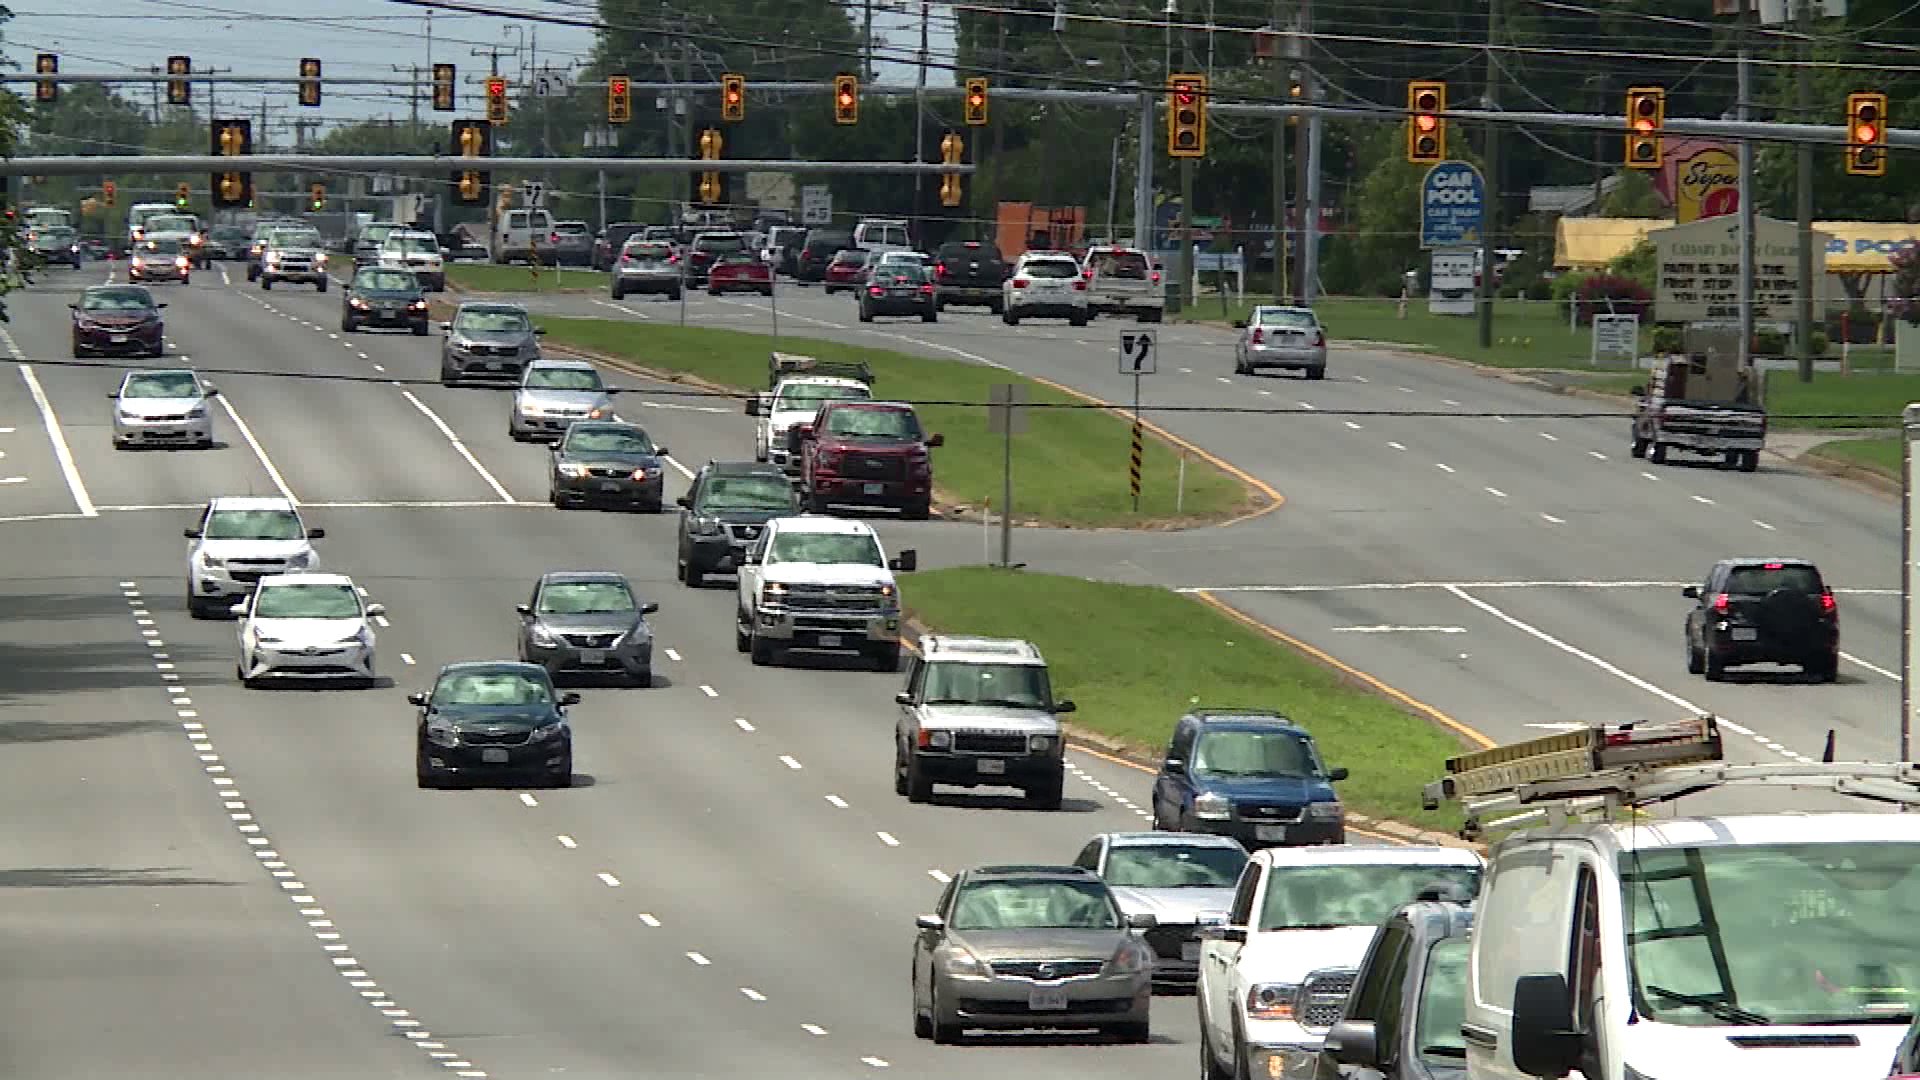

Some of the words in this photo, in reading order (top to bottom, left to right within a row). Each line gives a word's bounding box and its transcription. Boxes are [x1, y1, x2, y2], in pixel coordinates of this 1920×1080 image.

[1433, 172, 1472, 187] CAR
[1427, 189, 1480, 205] POOL
[1427, 208, 1449, 217] CAR
[1451, 208, 1480, 217] WASH
[1762, 264, 1785, 275] THE
